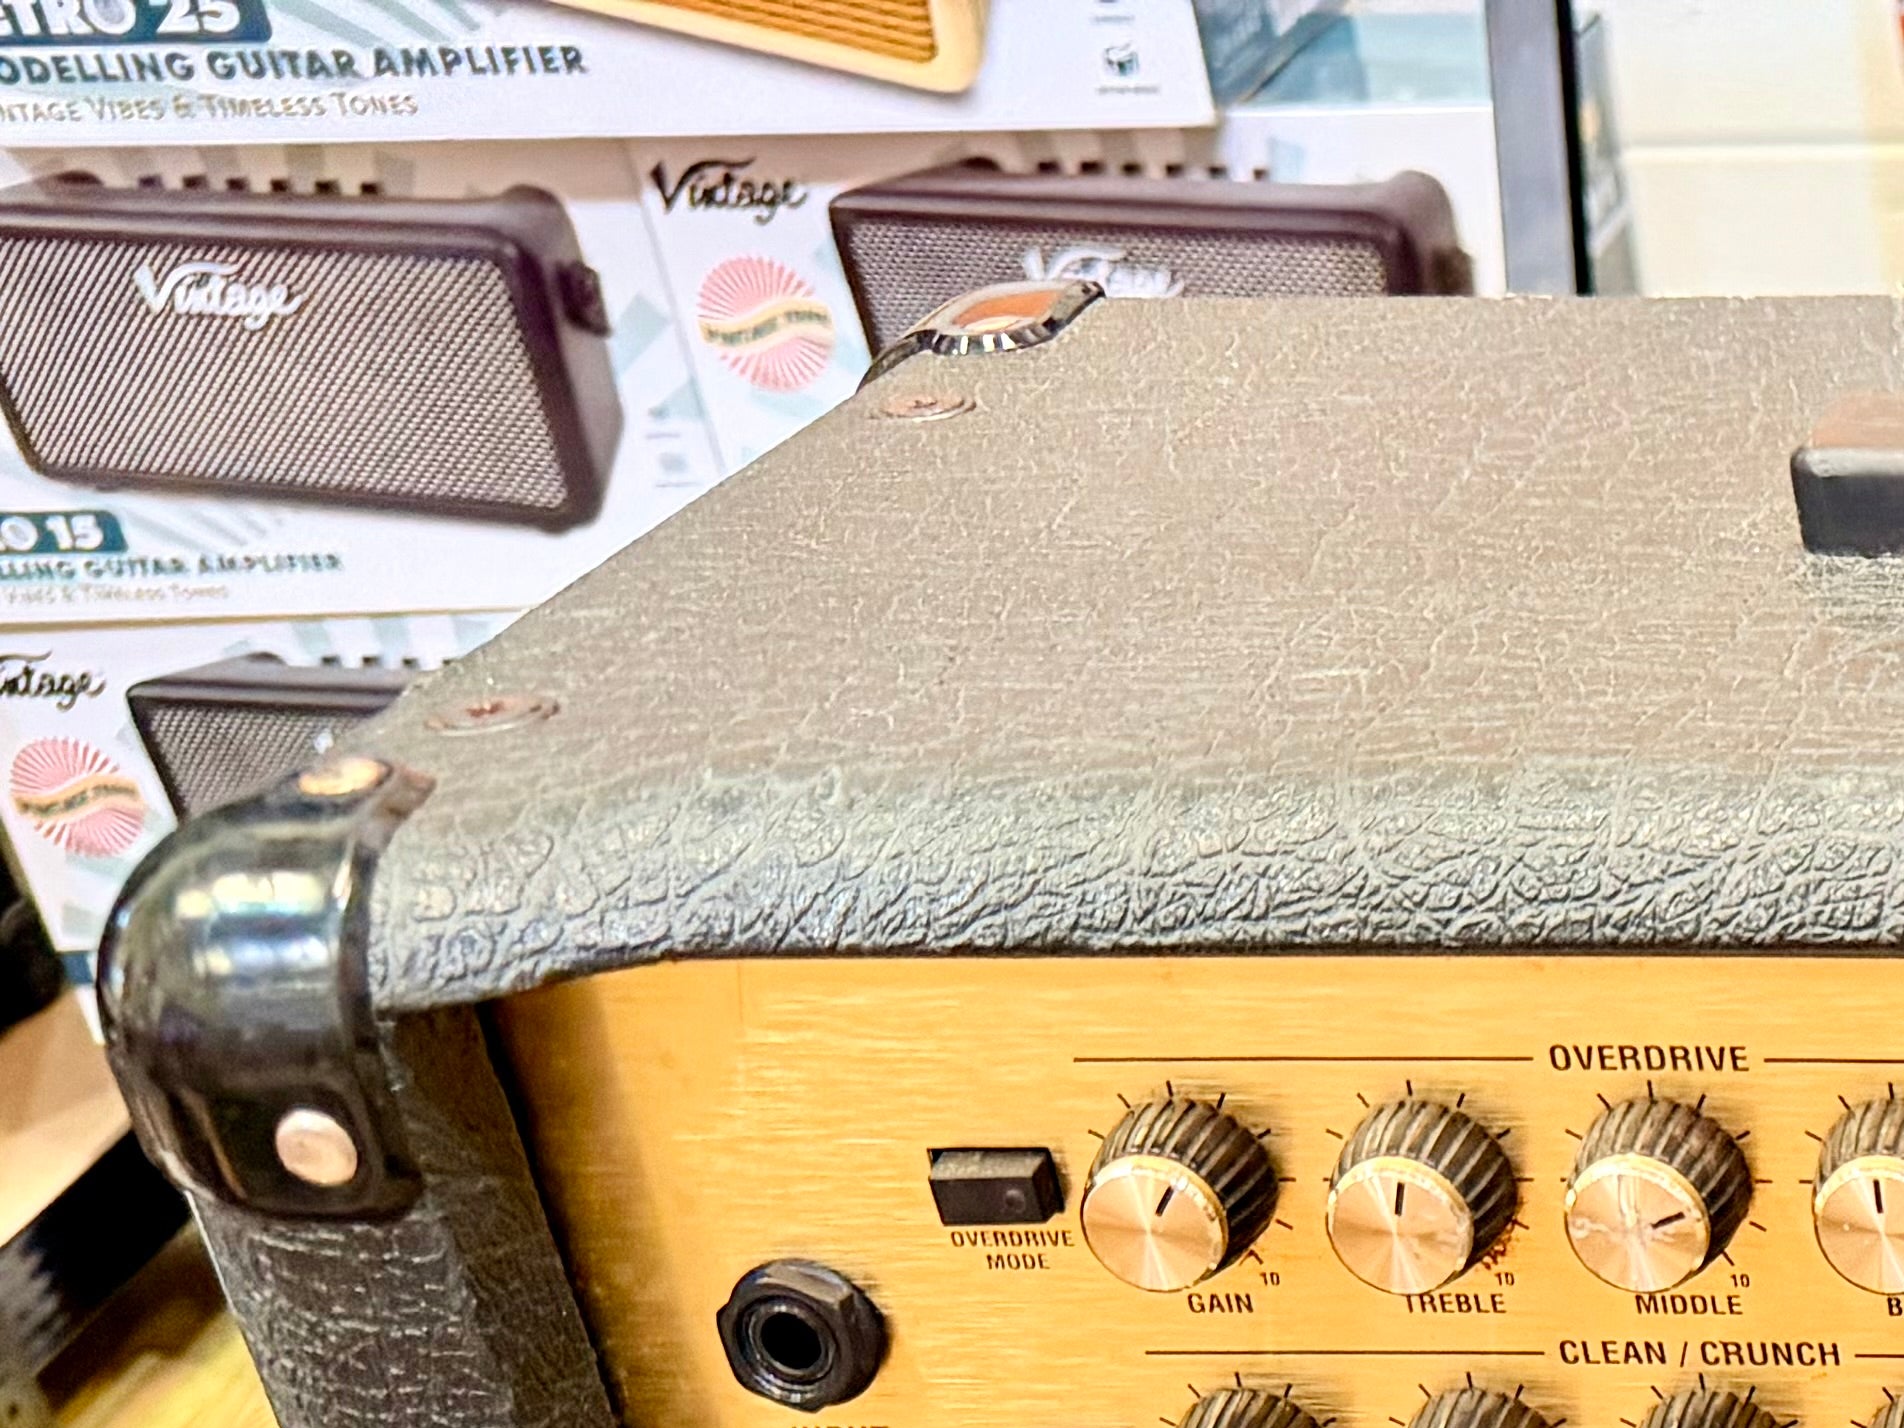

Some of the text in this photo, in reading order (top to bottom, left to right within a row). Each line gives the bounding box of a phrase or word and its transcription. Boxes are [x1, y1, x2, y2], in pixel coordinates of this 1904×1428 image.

[156, 0, 241, 35] 25
[207, 49, 359, 80] GUITAR
[373, 46, 589, 77] AMPLIFIER
[331, 92, 418, 117] TONES
[649, 157, 808, 226] Vintage
[134, 260, 304, 331] Vintage
[45, 514, 104, 550] 15
[1549, 1044, 1750, 1073] OVERDRIVE
[950, 1230, 1075, 1248] OVERDRIVE
[986, 1253, 1051, 1270] MODE
[1260, 1271, 1280, 1287] 10
[1495, 1272, 1515, 1287] 10
[1730, 1274, 1750, 1288] 10
[1187, 1292, 1254, 1314] GAIN
[1406, 1294, 1507, 1314] TREBLE
[1636, 1294, 1743, 1315] MIDDLE
[1560, 1340, 1666, 1365] CLEAN
[1701, 1340, 1841, 1367] CRUNCH
